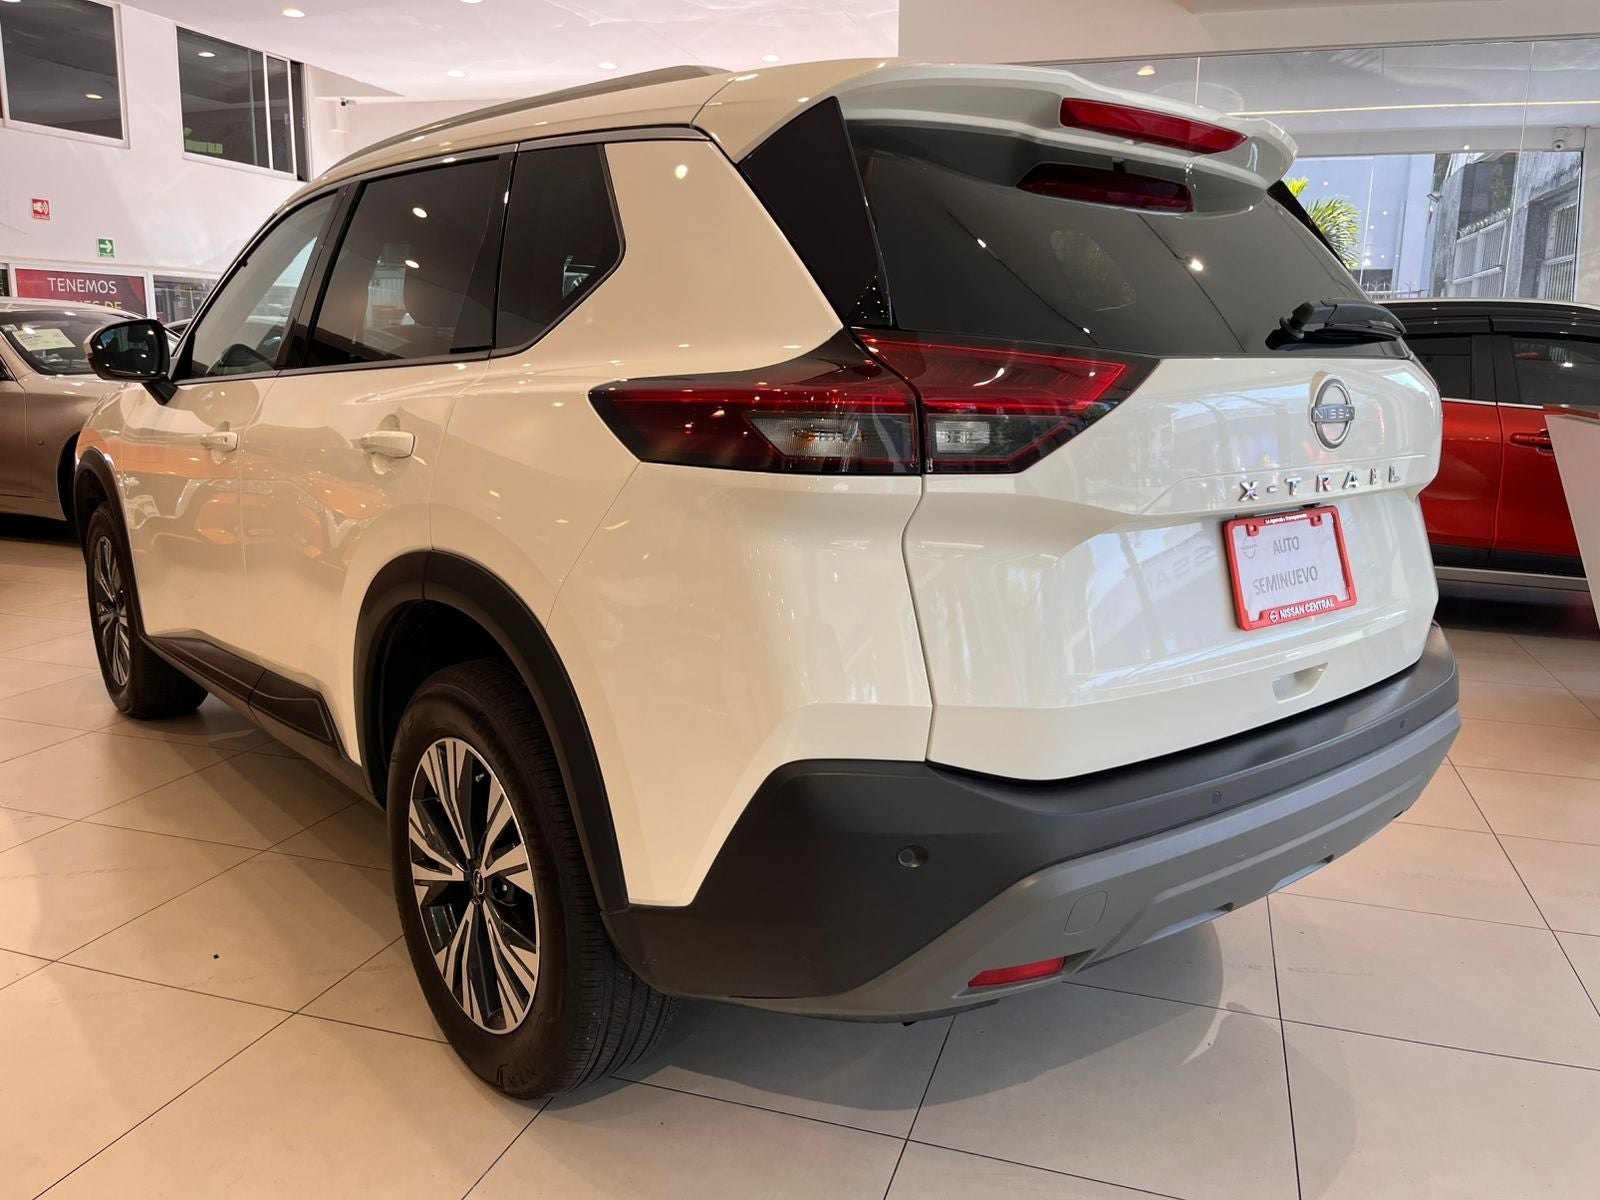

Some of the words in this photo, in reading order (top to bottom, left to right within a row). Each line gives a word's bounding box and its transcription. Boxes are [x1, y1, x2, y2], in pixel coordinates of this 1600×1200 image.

[47, 277, 117, 294] TENEMOS
[1239, 465, 1401, 501] X-TRAIL
[1272, 536, 1300, 555] AUTO
[1253, 565, 1319, 595] SEMINUEVO
[1279, 605, 1305, 619] NISSAN
[1304, 598, 1335, 613] CENTRAL
